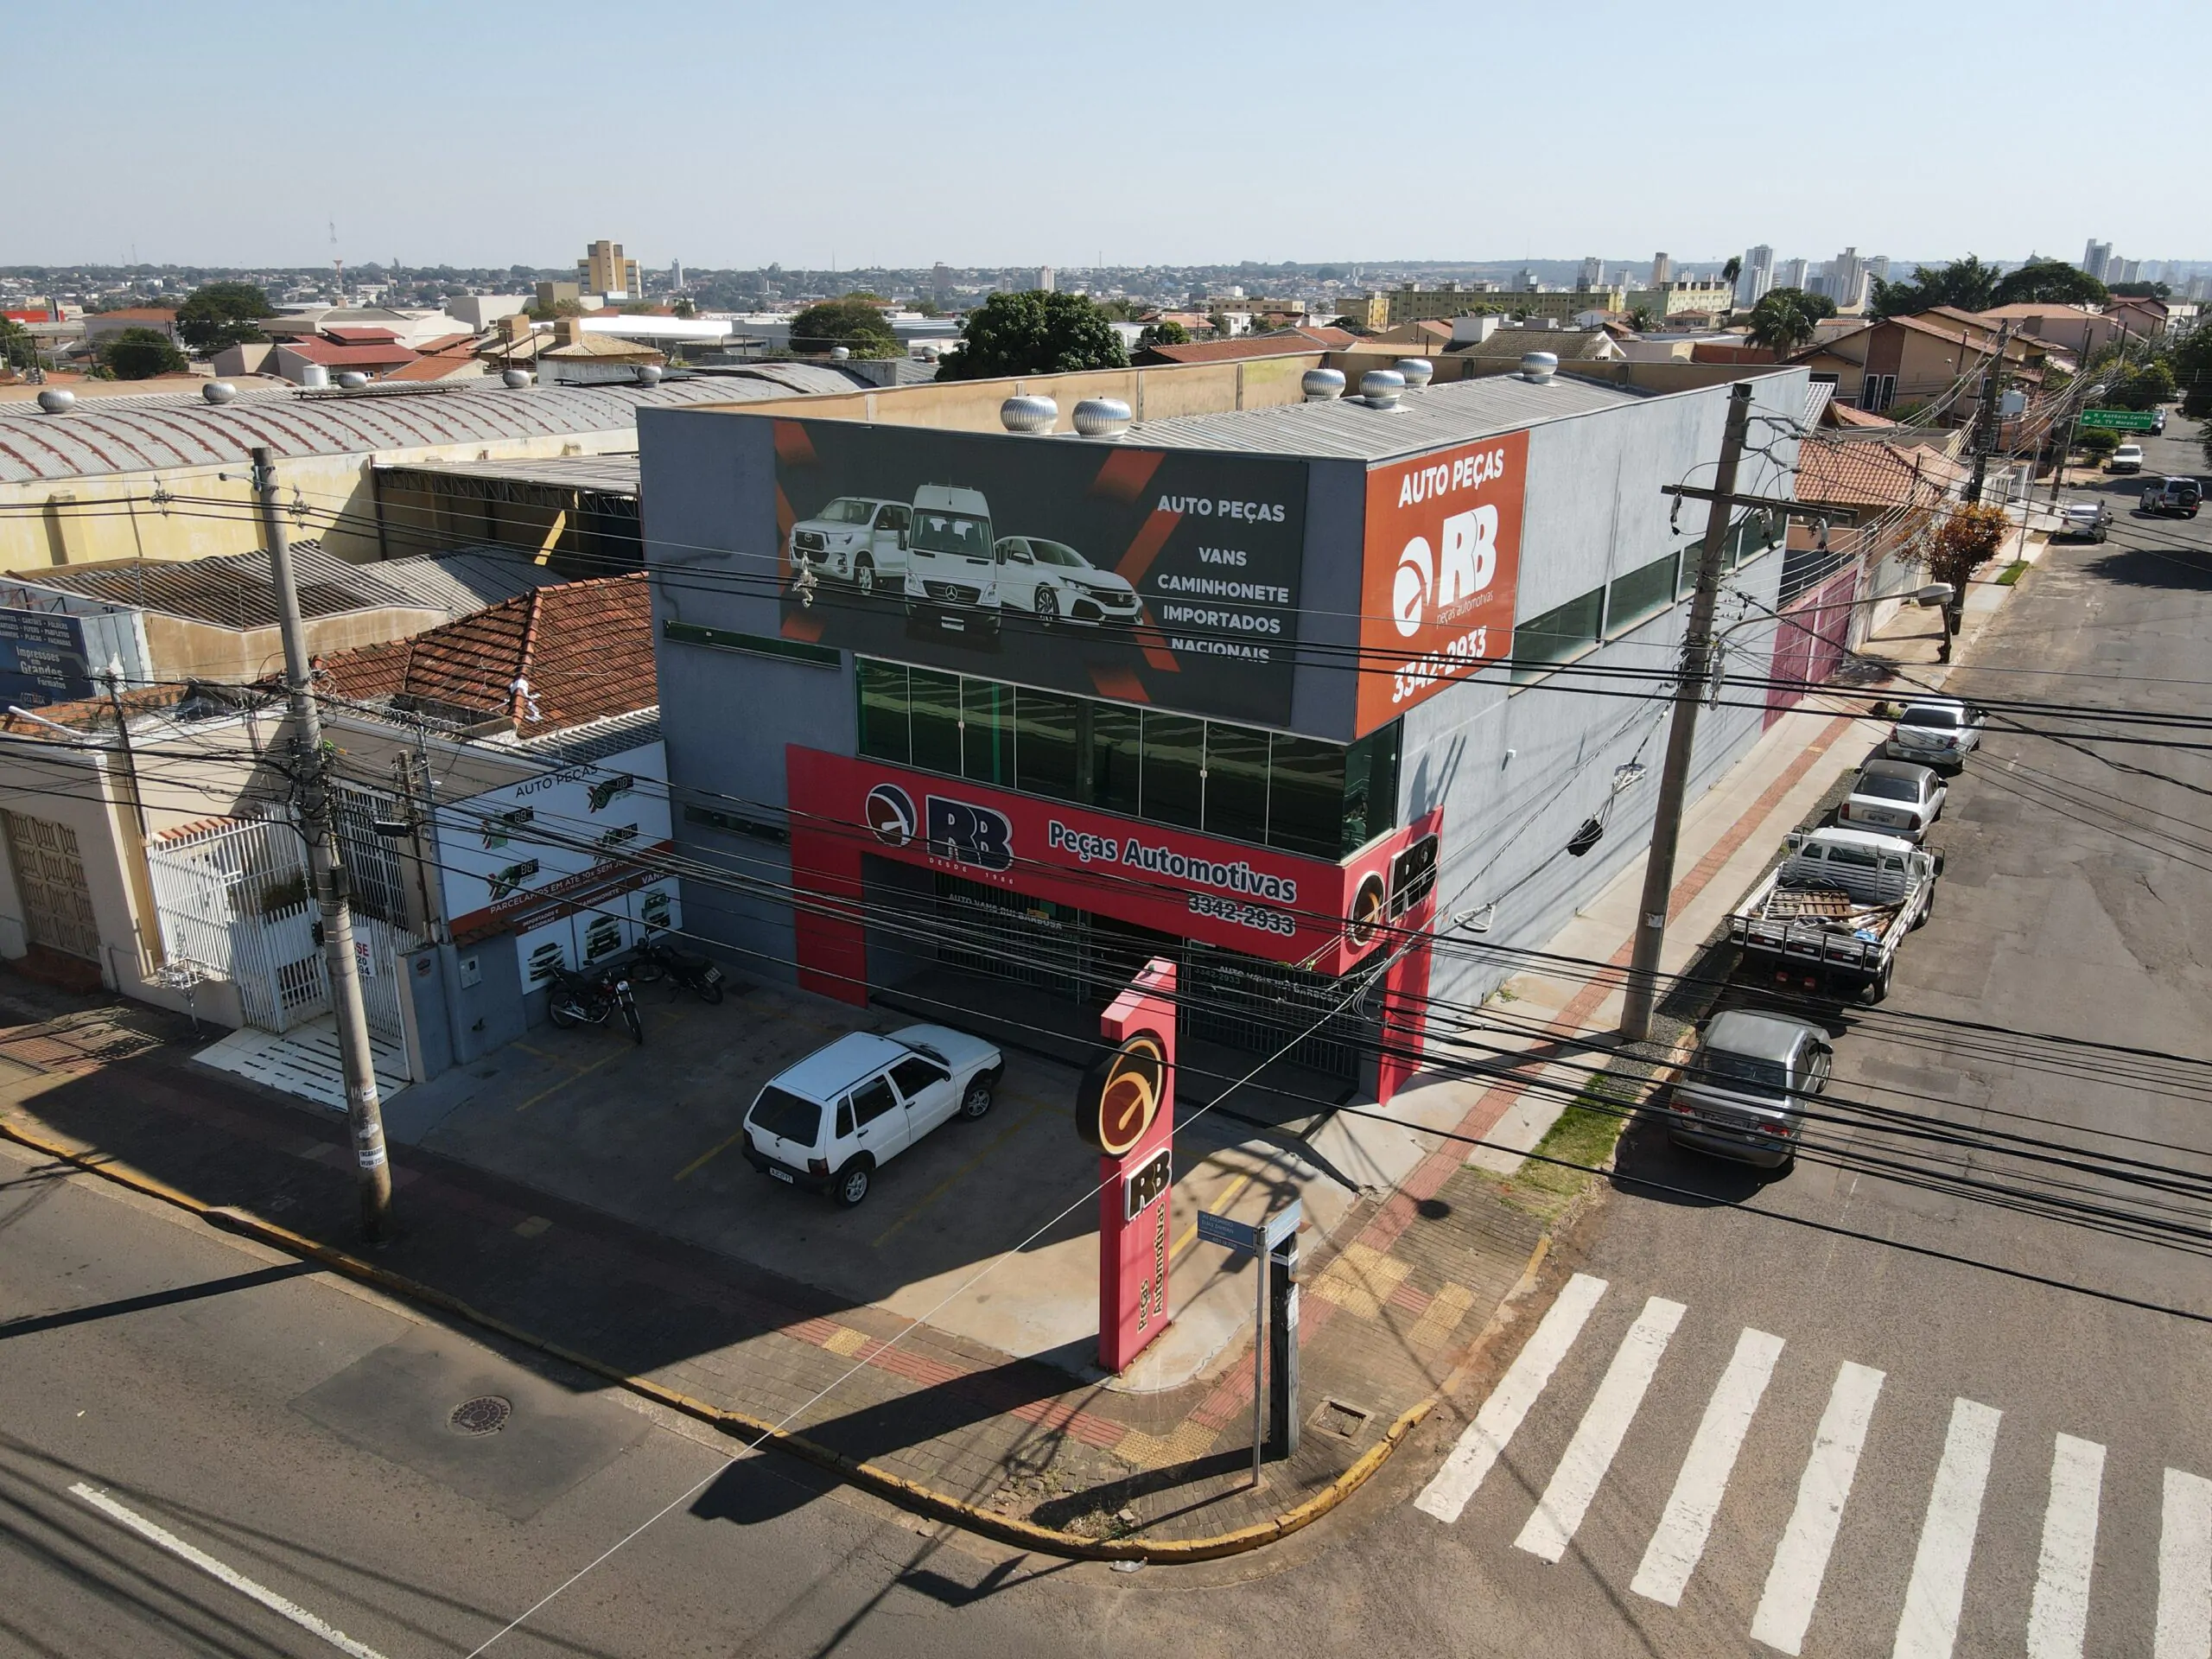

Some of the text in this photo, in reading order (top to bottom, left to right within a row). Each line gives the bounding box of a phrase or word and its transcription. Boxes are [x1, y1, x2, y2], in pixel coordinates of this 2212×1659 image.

[1398, 448, 1503, 508] AUTO PEÇAS
[1157, 495, 1285, 524] AUTO PEÇAS
[1198, 547, 1247, 566] VANS
[1438, 504, 1498, 608] RB
[1158, 574, 1289, 603] CAMINHONETE
[1163, 605, 1281, 634] IMPORTADOS
[1436, 590, 1493, 629] peças automotivas
[21, 660, 64, 681] Grandes
[1172, 638, 1269, 664] NACIONAIS
[1392, 625, 1487, 703] 3342-2933
[516, 778, 552, 798] AUTO
[926, 795, 1014, 873] RB
[550, 881, 563, 892] EM
[597, 863, 613, 875] SEM
[1049, 820, 1296, 903] Peças Automotivas
[949, 893, 972, 906] AUTO
[1188, 893, 1296, 937] 3342-2933
[1124, 1147, 1173, 1222] RB
[1153, 1201, 1166, 1318] Automotivas
[1137, 1278, 1152, 1335] Peças
